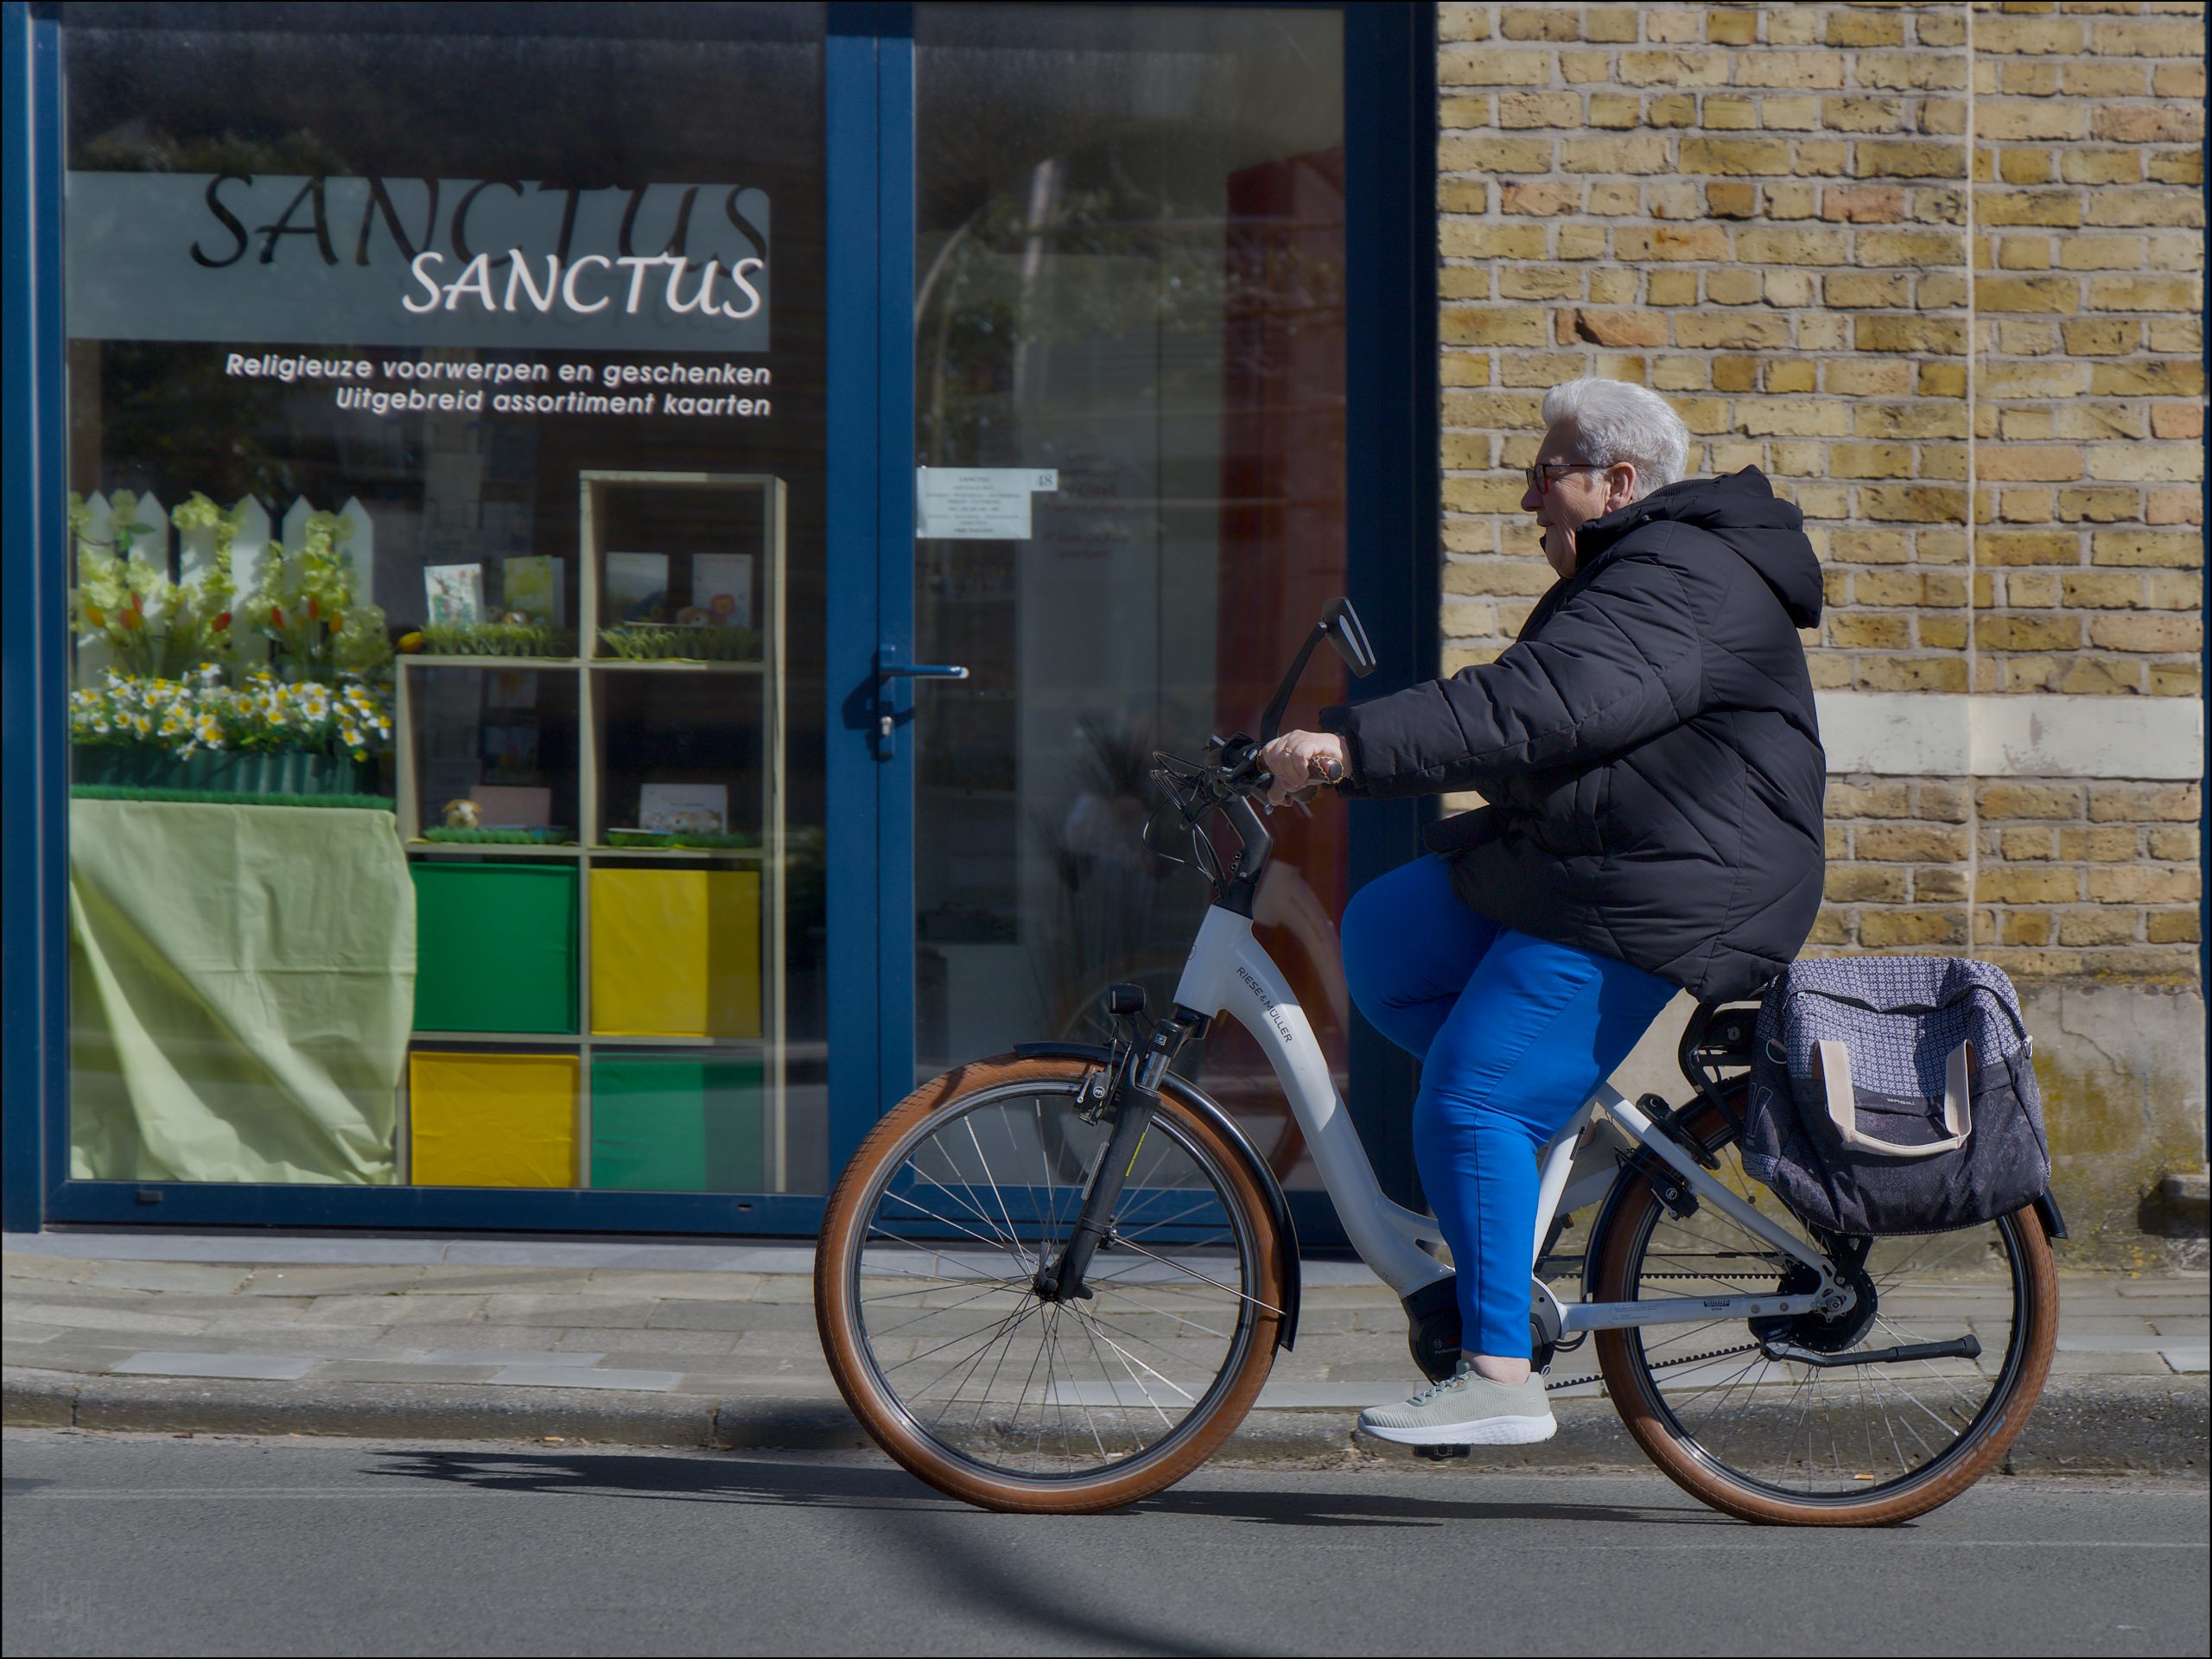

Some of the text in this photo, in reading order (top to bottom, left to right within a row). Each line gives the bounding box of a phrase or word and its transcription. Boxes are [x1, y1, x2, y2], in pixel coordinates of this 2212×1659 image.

[403, 249, 764, 319] SANCTUS
[226, 353, 772, 386] Religieuze voorwerpen en geschenken
[336, 387, 772, 416] Uitgebreid assortiment kaarten
